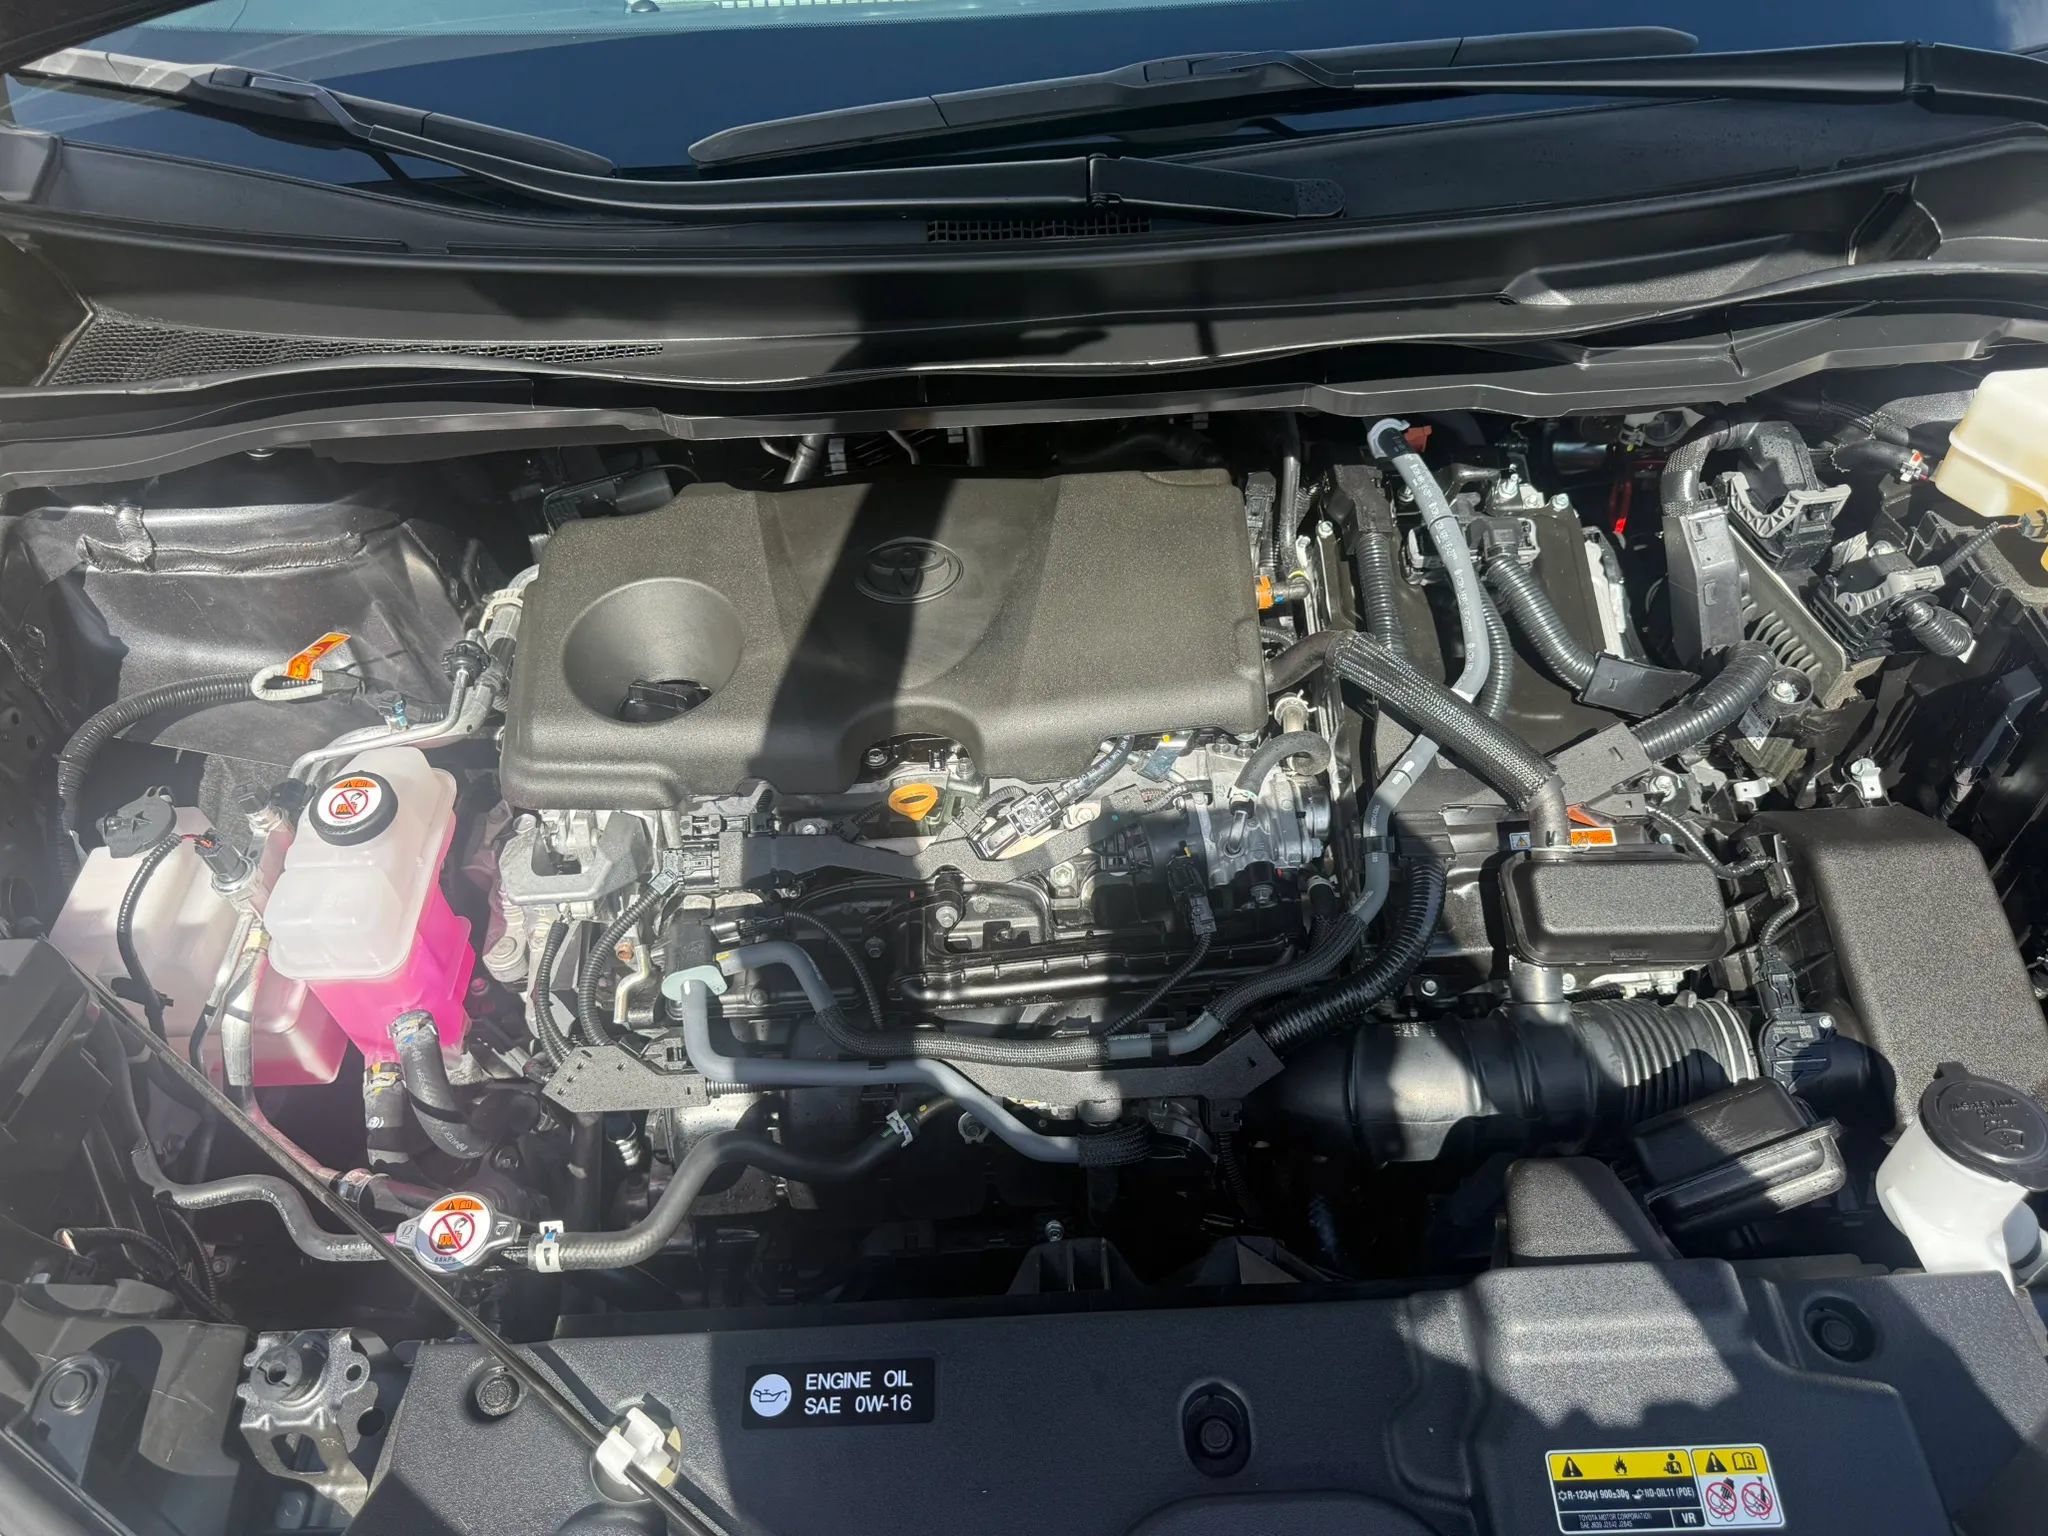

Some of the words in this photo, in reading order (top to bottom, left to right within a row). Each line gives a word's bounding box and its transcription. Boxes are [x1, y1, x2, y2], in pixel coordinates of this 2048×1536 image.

[805, 1371, 872, 1390] ENGINE
[883, 1370, 913, 1388] OIL
[804, 1396, 841, 1415] SAE
[855, 1394, 912, 1413] 0W-16
[1578, 1513, 1598, 1521] TOYOTA
[1681, 1512, 1697, 1524] VR
